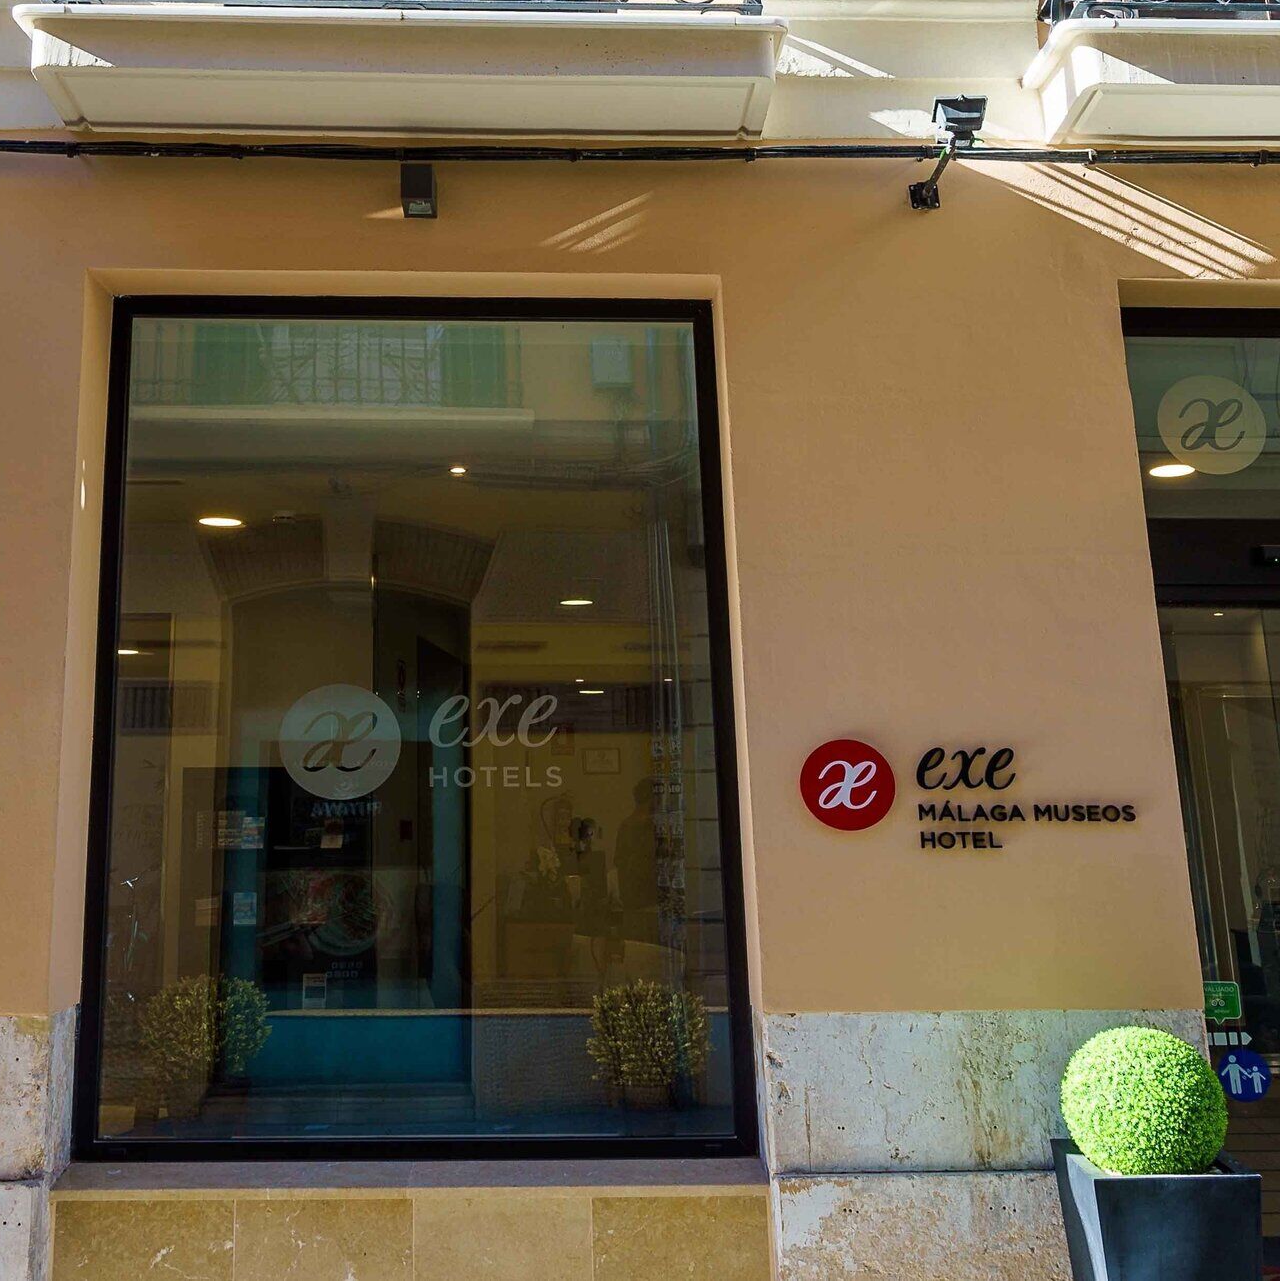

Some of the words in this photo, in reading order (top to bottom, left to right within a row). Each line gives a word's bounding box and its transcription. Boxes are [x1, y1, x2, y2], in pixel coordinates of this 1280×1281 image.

[427, 693, 559, 749] exe
[428, 765, 564, 788] HOTELS
[916, 745, 1017, 791] exe
[918, 799, 1025, 822] MÁLAGA
[1033, 804, 1137, 822] MUSEOS
[919, 831, 1003, 850] HOTEL
